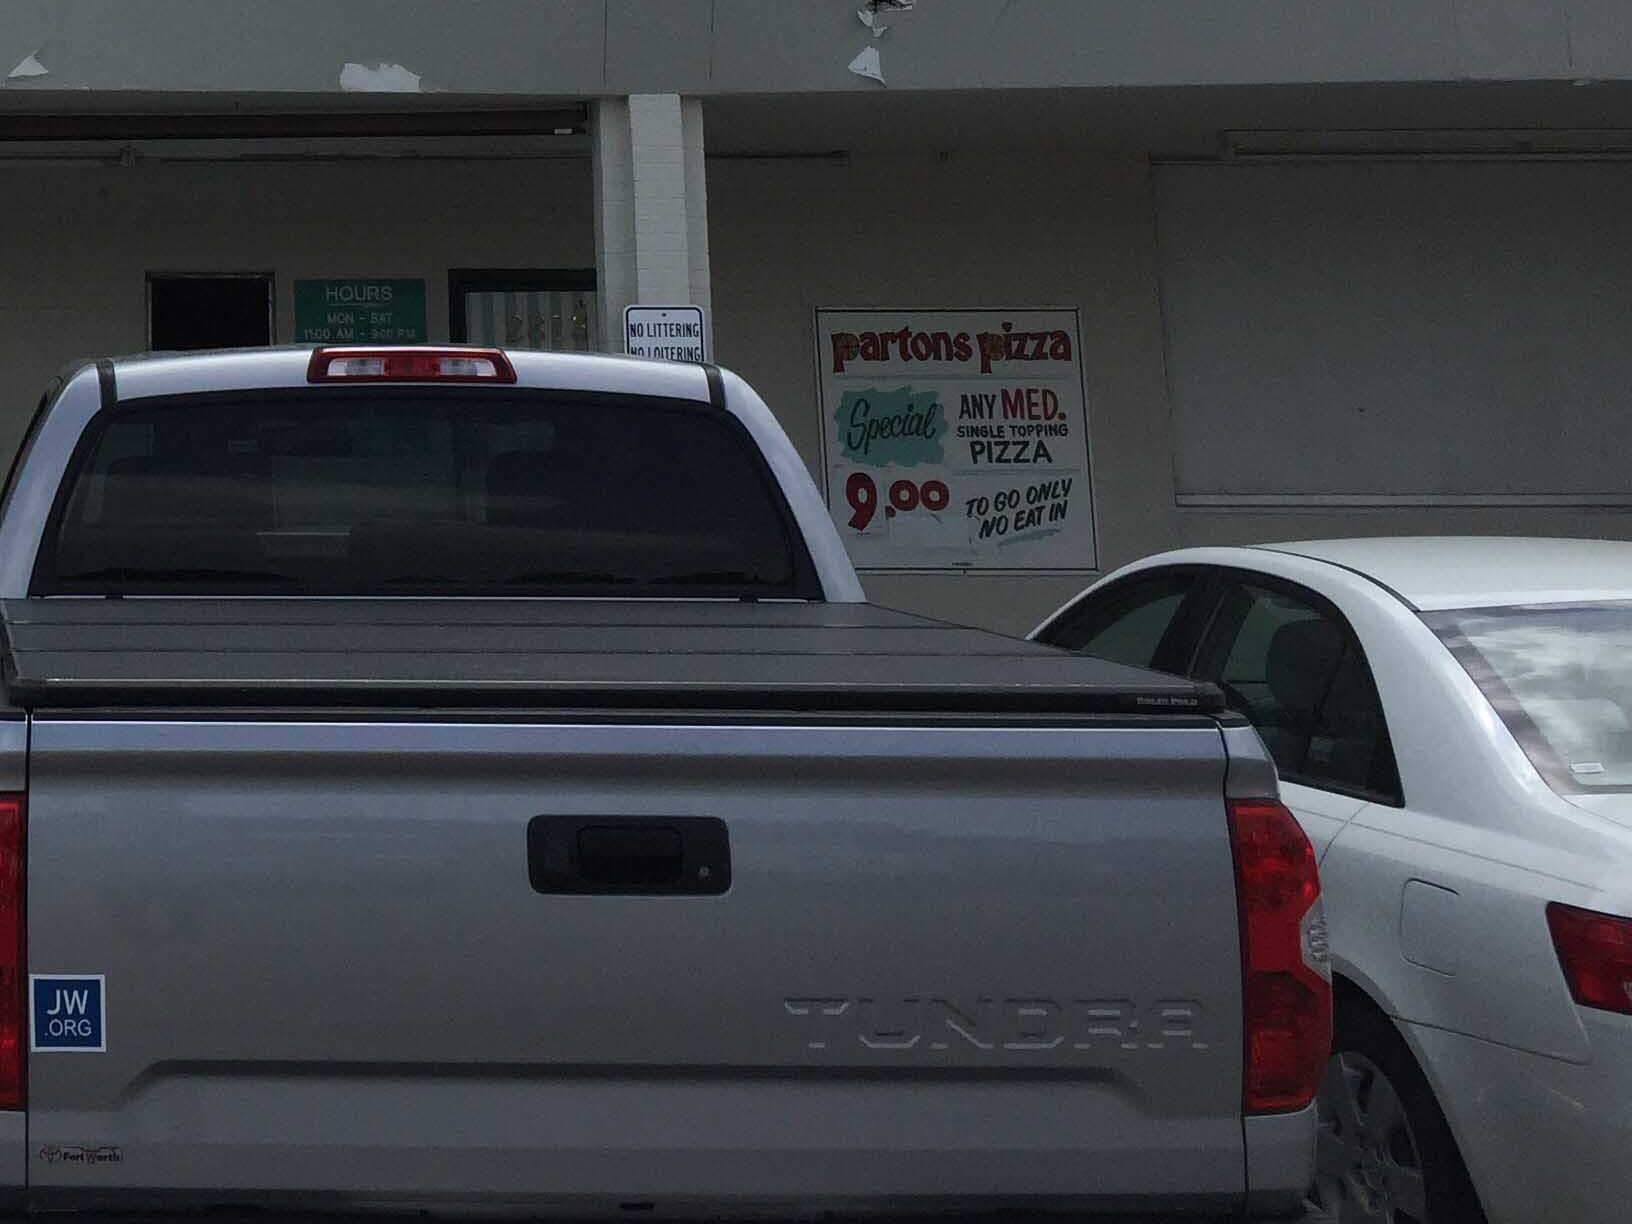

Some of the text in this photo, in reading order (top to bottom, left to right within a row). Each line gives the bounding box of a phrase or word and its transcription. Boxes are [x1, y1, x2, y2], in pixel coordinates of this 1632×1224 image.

[325, 285, 393, 301] HOURS
[327, 312, 354, 324] MON
[369, 312, 392, 324] SAT
[630, 322, 699, 338] NO LITTERING
[830, 322, 1072, 373] partons pizza
[959, 389, 1066, 421] ANY MED.
[847, 398, 936, 455] Special
[957, 424, 1069, 438] SINGLE TOPPING
[970, 441, 1053, 464] PIZZA
[845, 472, 950, 532] 9.00
[966, 478, 1072, 518] TO GO ONLY
[979, 500, 1068, 539] NO EAT IN
[46, 989, 89, 1015] JW
[784, 997, 1209, 1050] TUNDRA
